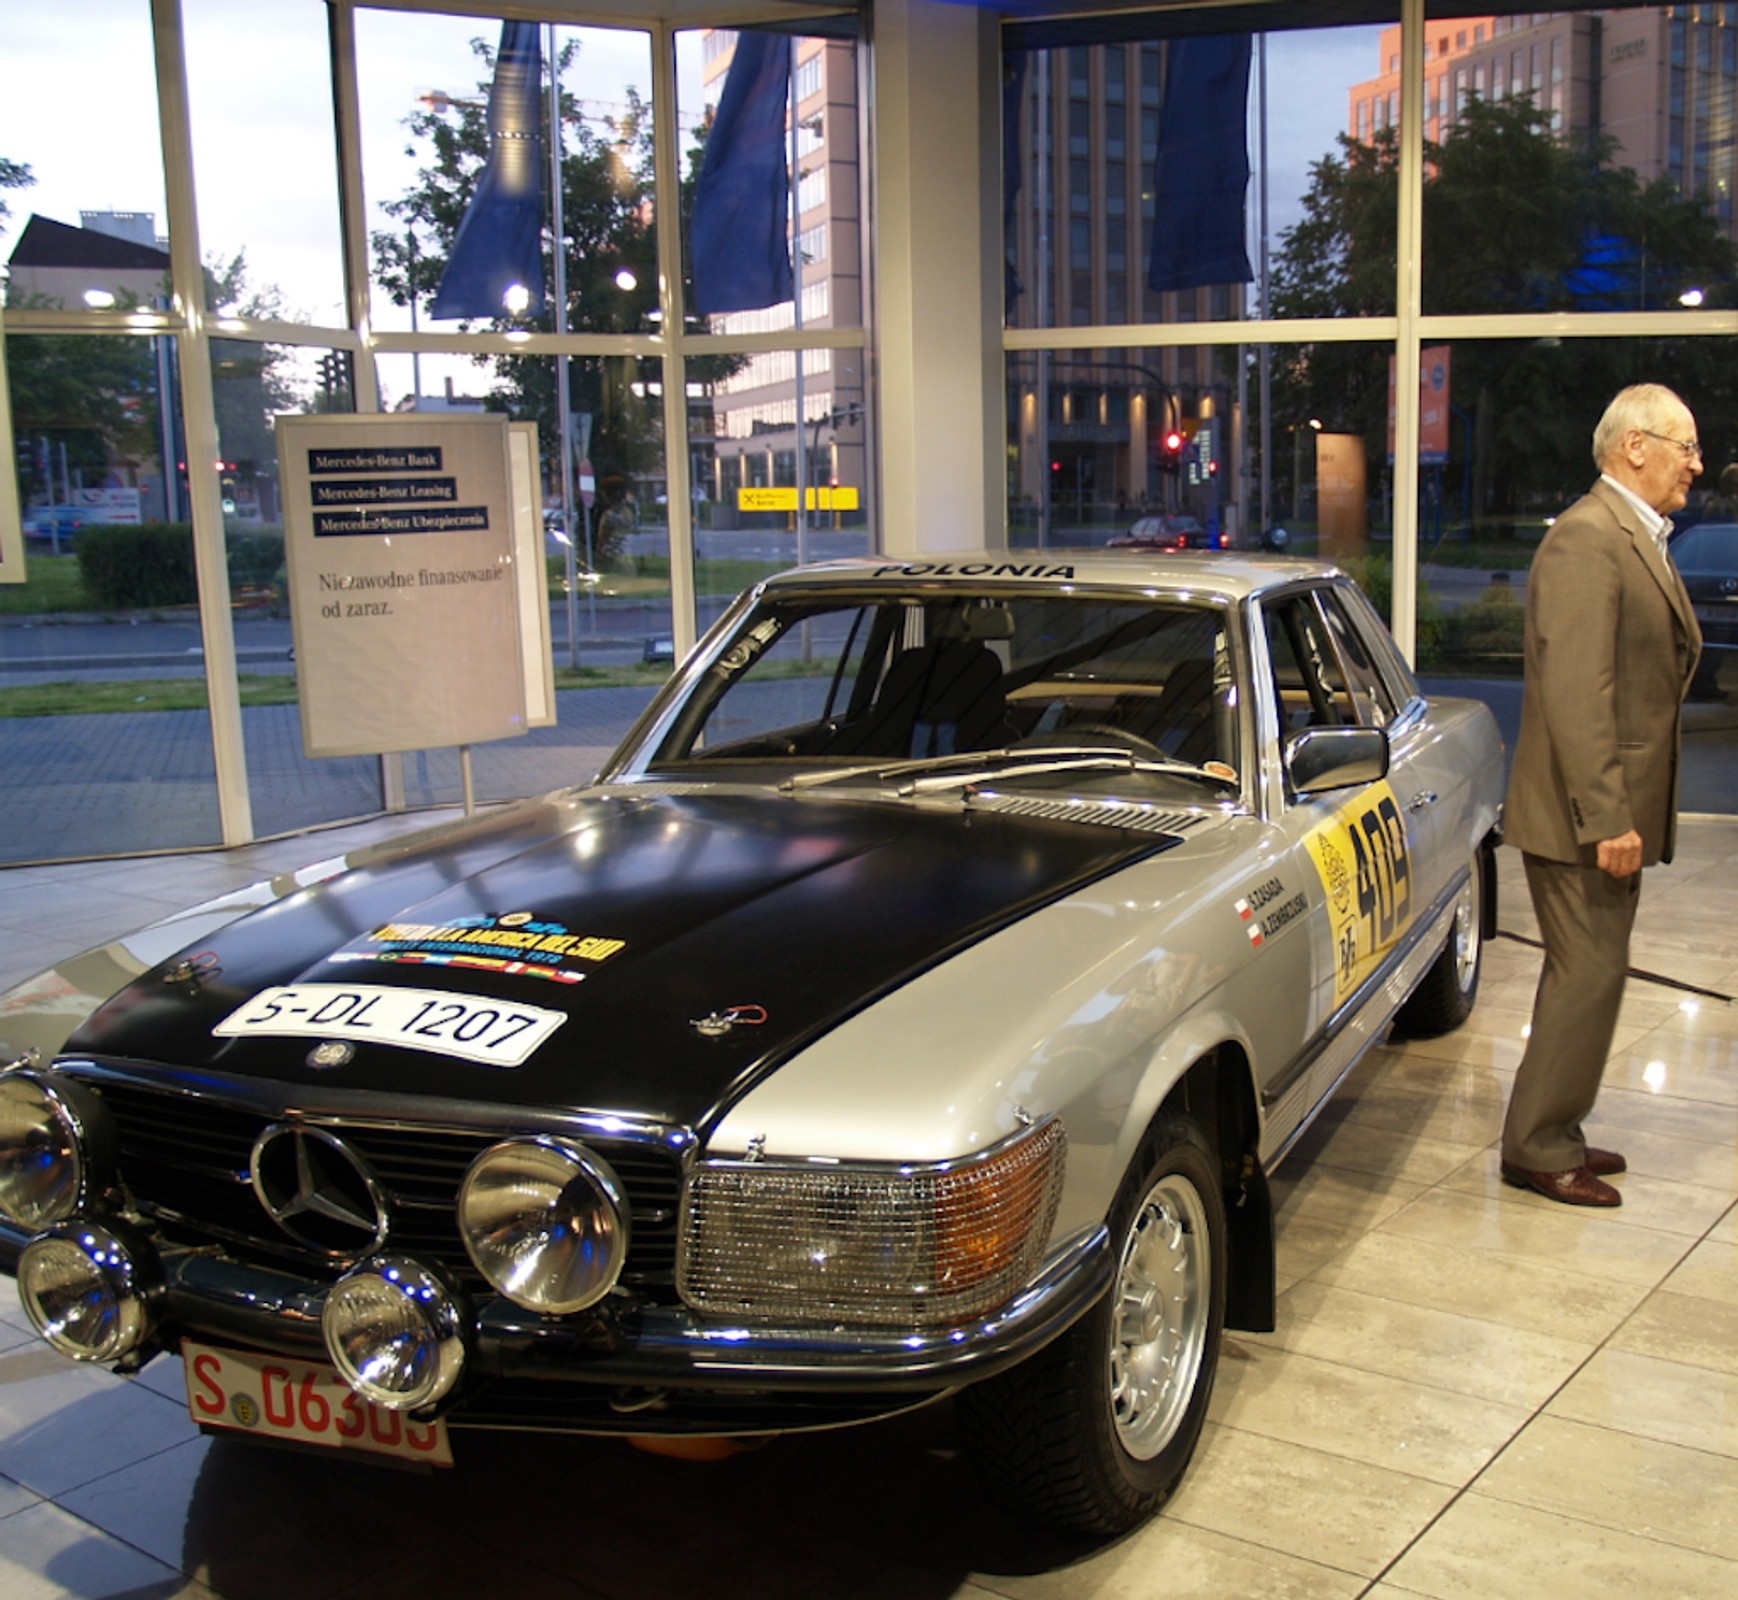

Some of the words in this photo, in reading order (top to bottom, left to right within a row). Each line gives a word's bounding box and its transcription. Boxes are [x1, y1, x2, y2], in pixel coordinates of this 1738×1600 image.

[316, 454, 405, 468] Mercedes-Benz
[408, 453, 436, 466] Bank
[318, 486, 407, 500] Mercedes-Benz
[410, 484, 452, 499] Leasing
[321, 515, 410, 531] Mercedes-Benz
[412, 513, 485, 529] Ubezpieczenia
[319, 571, 415, 592] Niezawodne
[418, 564, 502, 586] finansowanie
[872, 563, 1075, 579] POLONIA
[322, 601, 341, 618] od
[346, 601, 393, 617] zaraz.
[1349, 796, 1411, 955] 409
[245, 993, 383, 1028] S-DL
[401, 1000, 539, 1049] 1207
[193, 1353, 227, 1415] S
